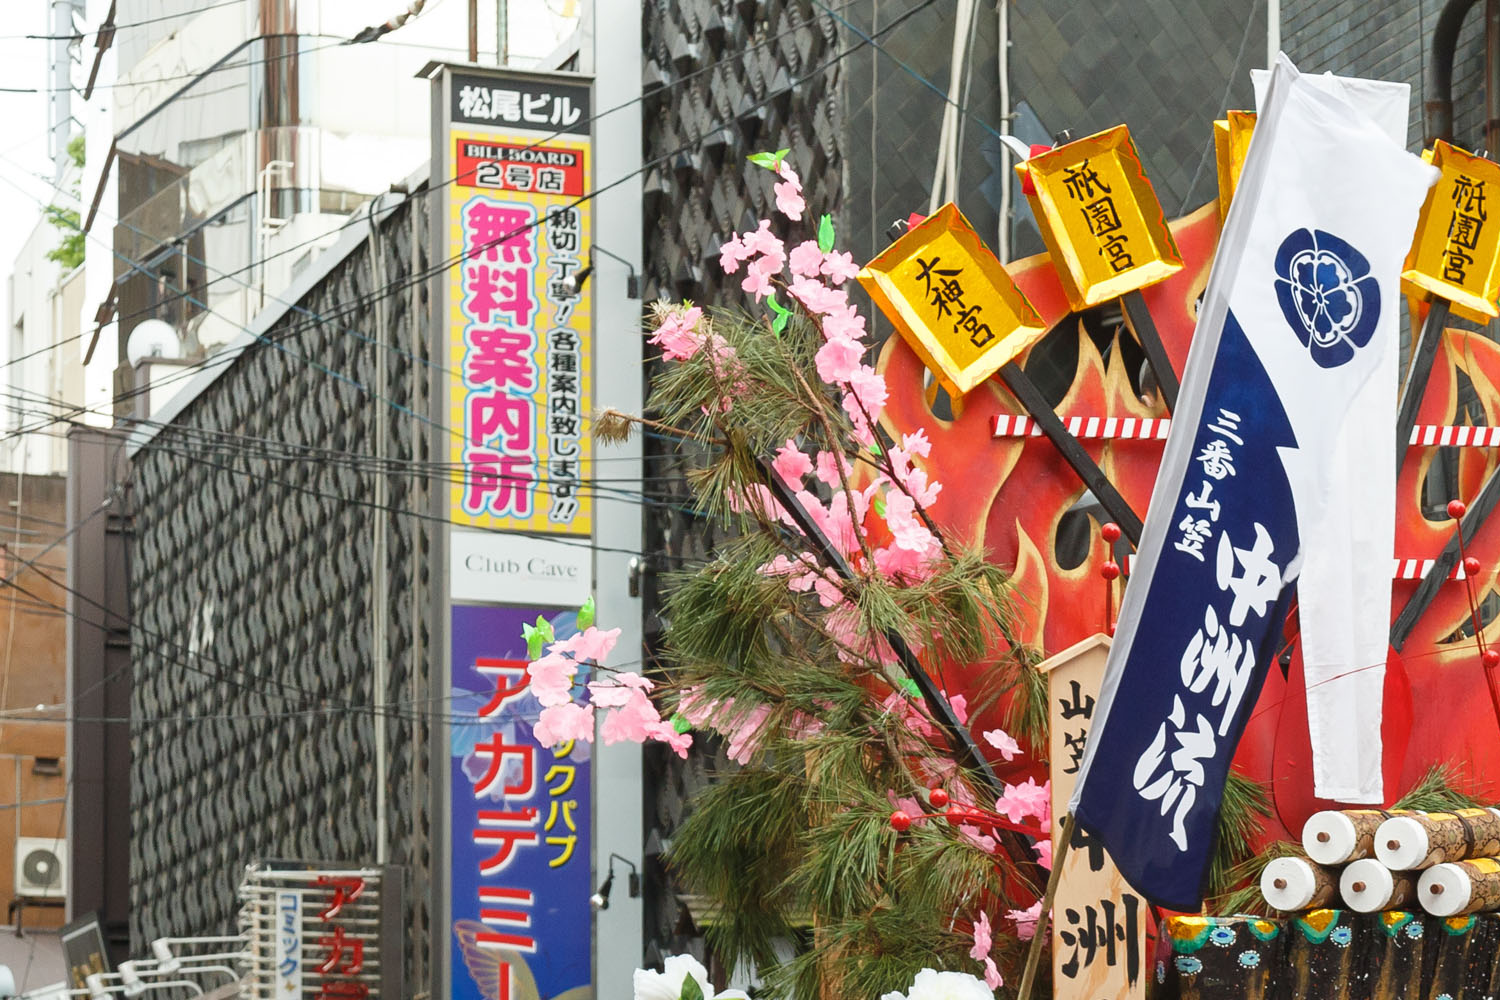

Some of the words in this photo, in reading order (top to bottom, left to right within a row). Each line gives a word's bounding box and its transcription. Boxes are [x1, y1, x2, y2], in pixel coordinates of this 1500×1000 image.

[459, 85, 581, 127] 松尾ビル
[467, 145, 574, 165] BILLBOARD
[477, 162, 564, 192] 2号店
[915, 256, 994, 348] 大神宮
[466, 202, 534, 514] 無料案内所
[1174, 408, 1244, 562] 三番山笠
[465, 553, 520, 574] Club
[527, 557, 578, 577] Cave
[1133, 522, 1283, 852] 中洲流
